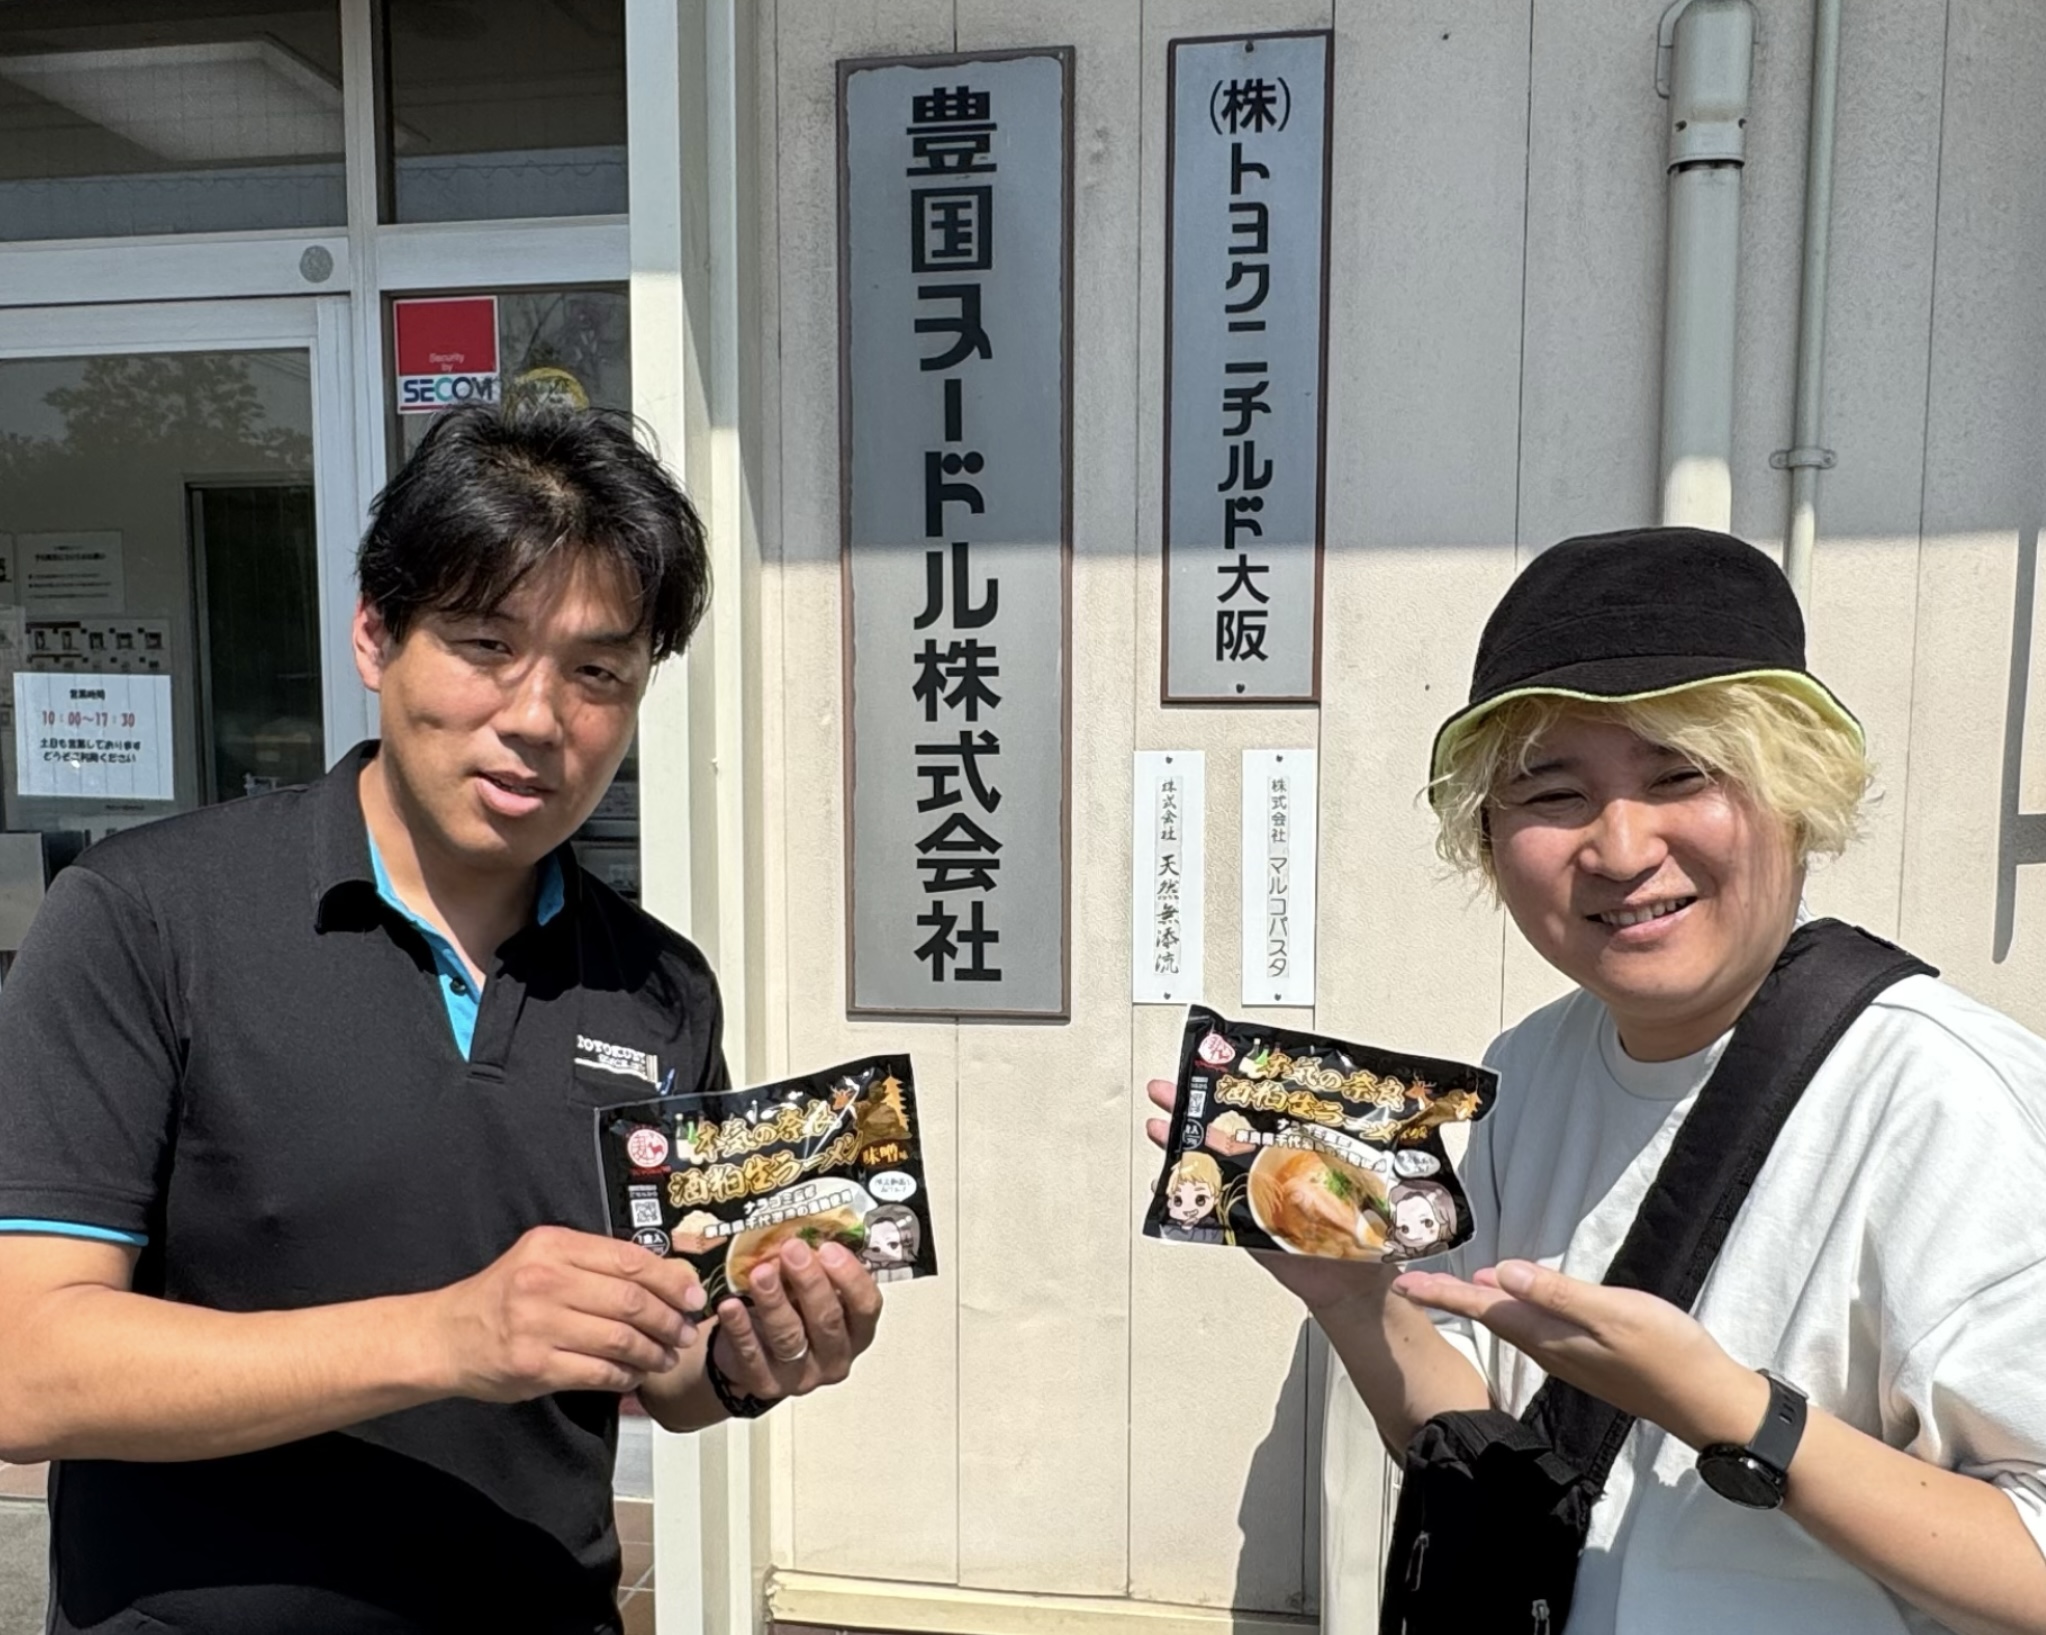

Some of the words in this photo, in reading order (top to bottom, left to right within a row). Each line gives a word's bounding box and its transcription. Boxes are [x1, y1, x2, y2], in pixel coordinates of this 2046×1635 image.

[404, 376, 493, 403] SECOM
[429, 352, 464, 363] Security
[905, 85, 1003, 982] 豊国ヌードル株式会社
[1160, 778, 1178, 842] 株式会社
[1270, 778, 1288, 844] 株式会社
[1268, 856, 1289, 978] マルコパスタ
[1262, 1053, 1405, 1112] 本気の奈良
[668, 1130, 864, 1207] 酒粕生ラーメン
